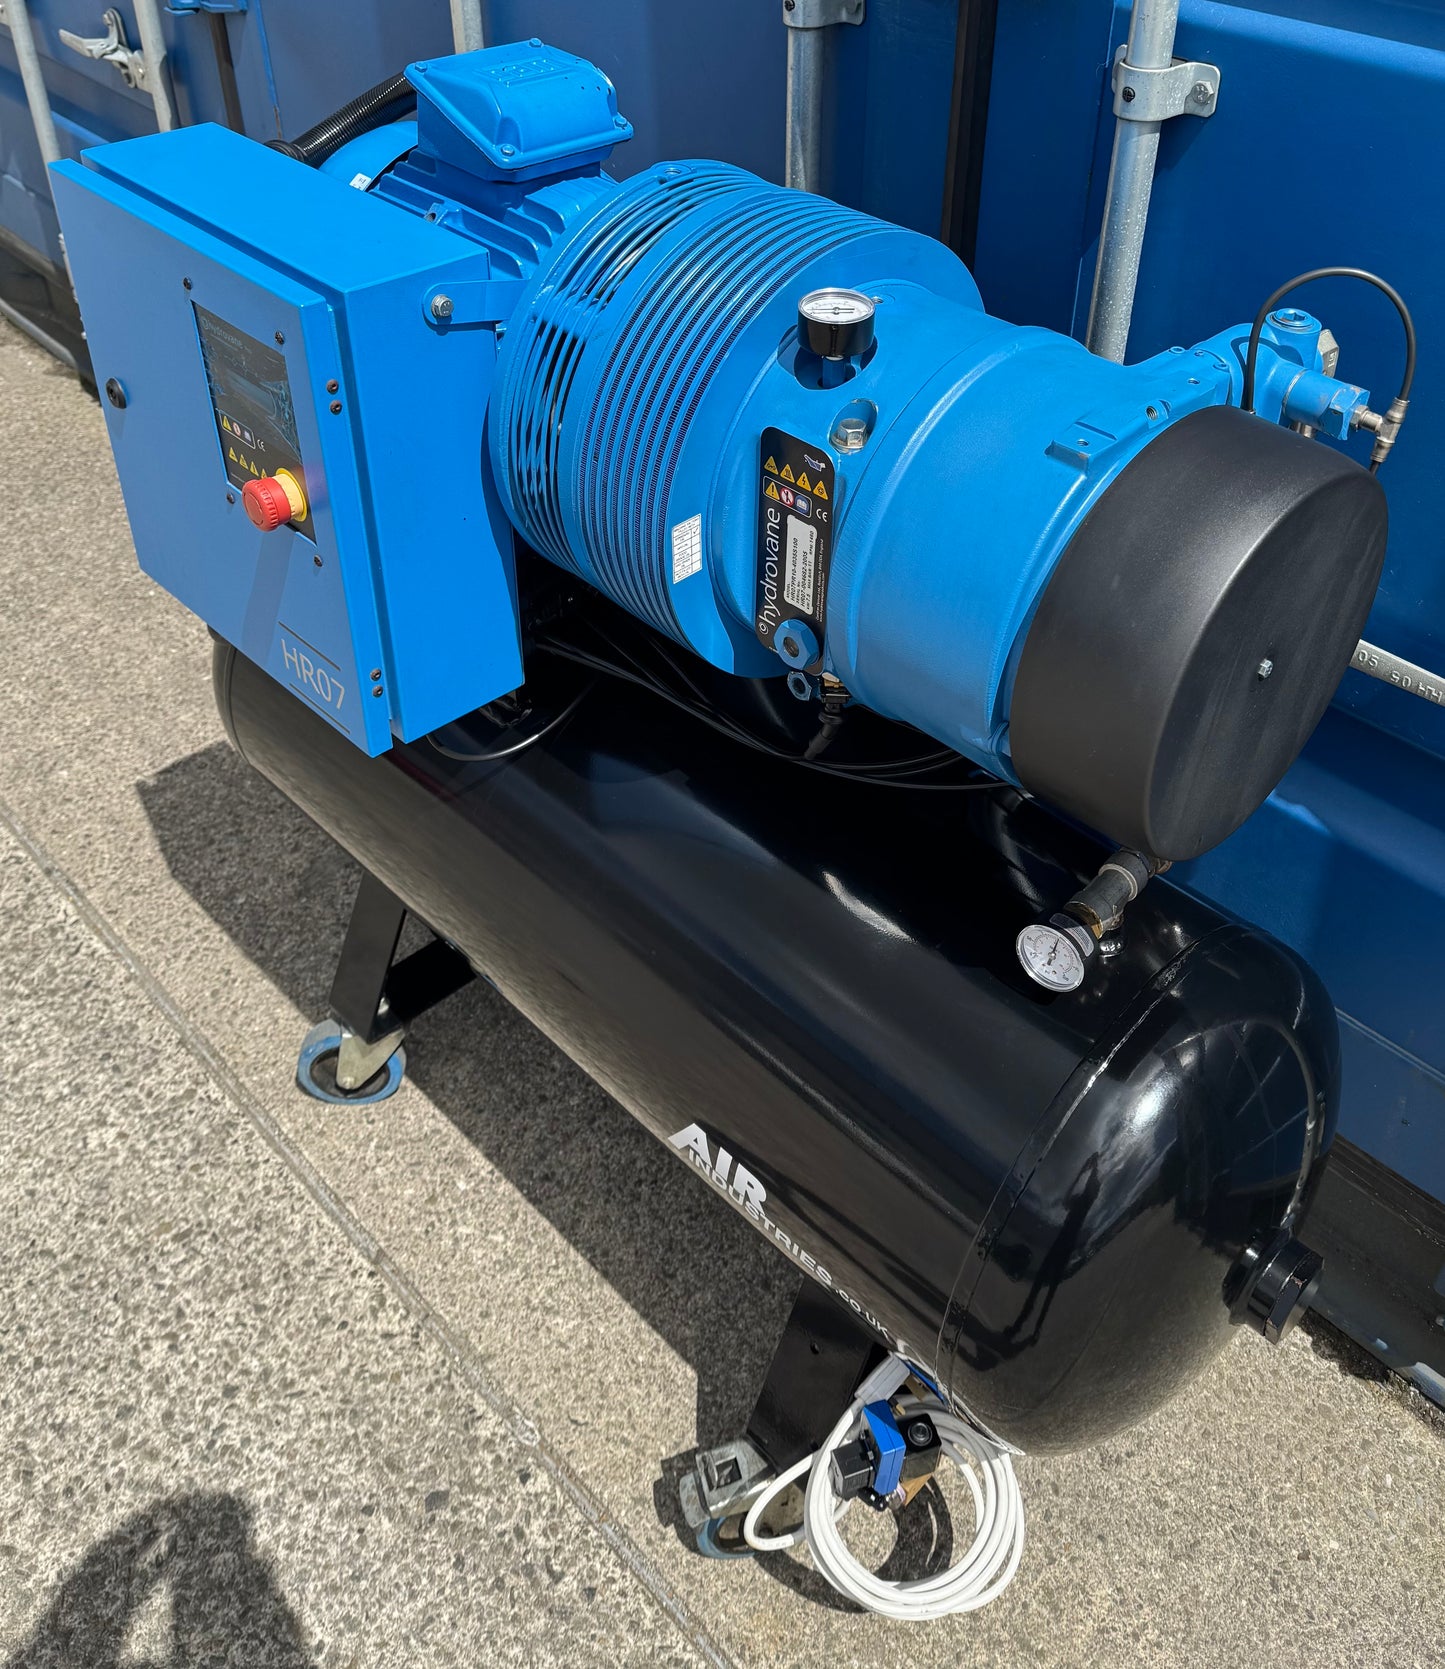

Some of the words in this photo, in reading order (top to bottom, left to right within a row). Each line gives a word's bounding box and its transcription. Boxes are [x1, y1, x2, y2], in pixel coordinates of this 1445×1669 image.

[759, 507, 781, 627] hydrovane
[281, 639, 345, 709] HR07
[667, 1122, 766, 1215] AIR
